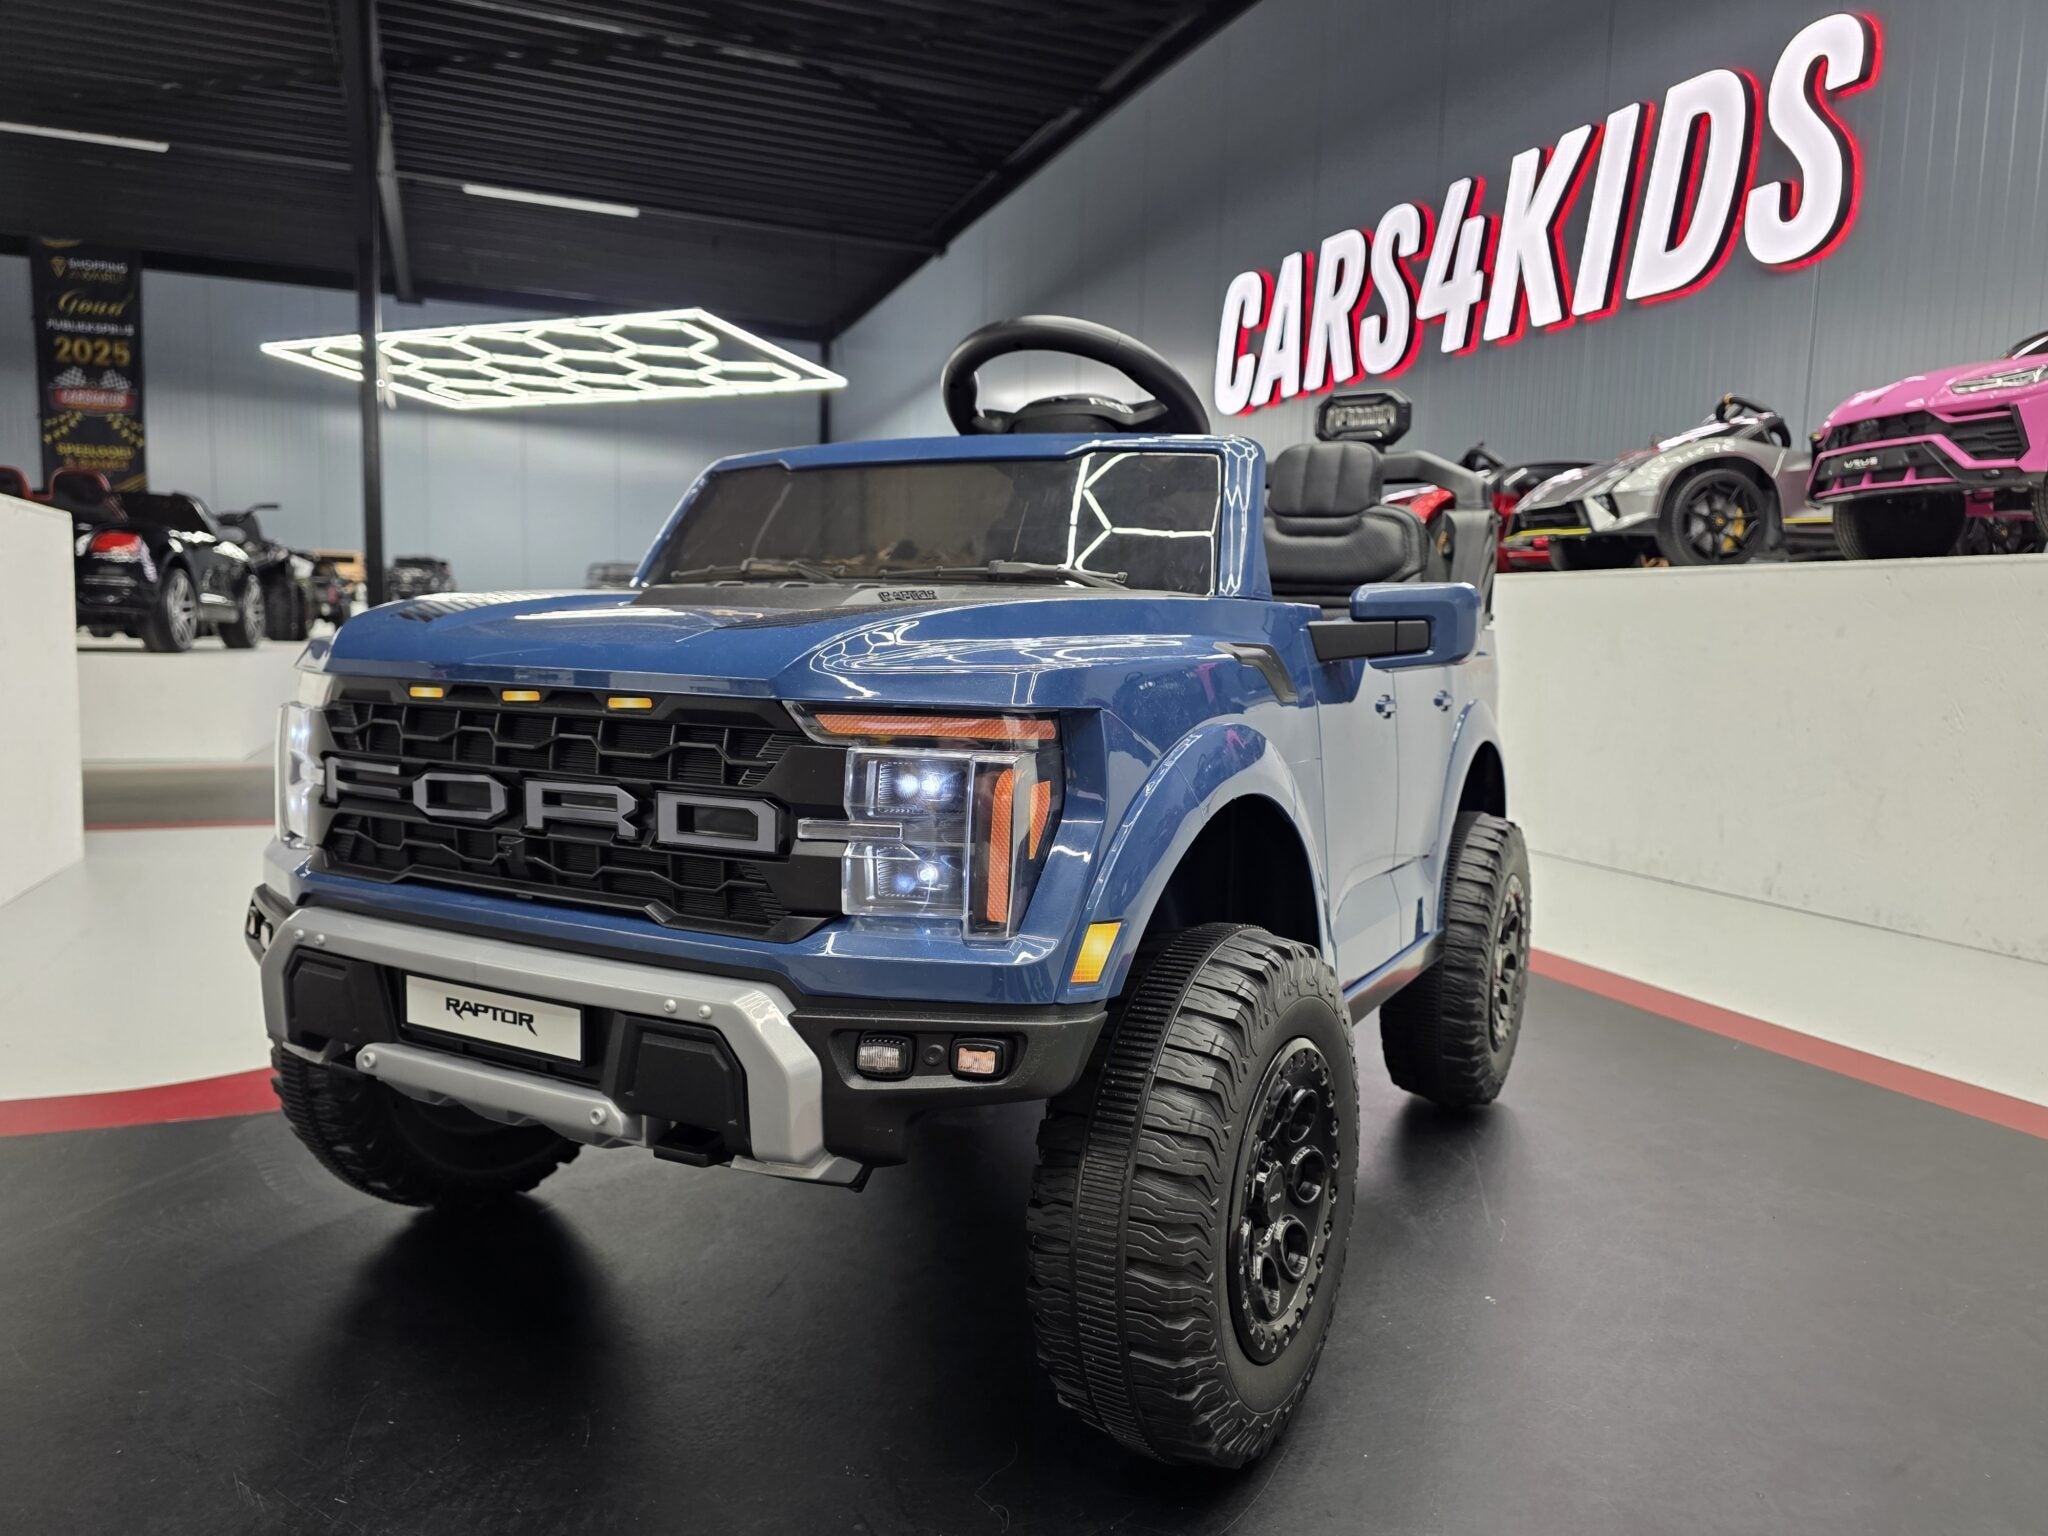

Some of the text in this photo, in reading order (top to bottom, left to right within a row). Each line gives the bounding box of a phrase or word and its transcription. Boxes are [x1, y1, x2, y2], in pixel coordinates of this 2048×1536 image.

[1214, 12, 1878, 417] CARS4KIDS
[54, 336, 130, 366] 2025
[878, 589, 938, 602] RAPTOR
[323, 756, 778, 853] FORD
[445, 997, 538, 1037] RAPTOR
